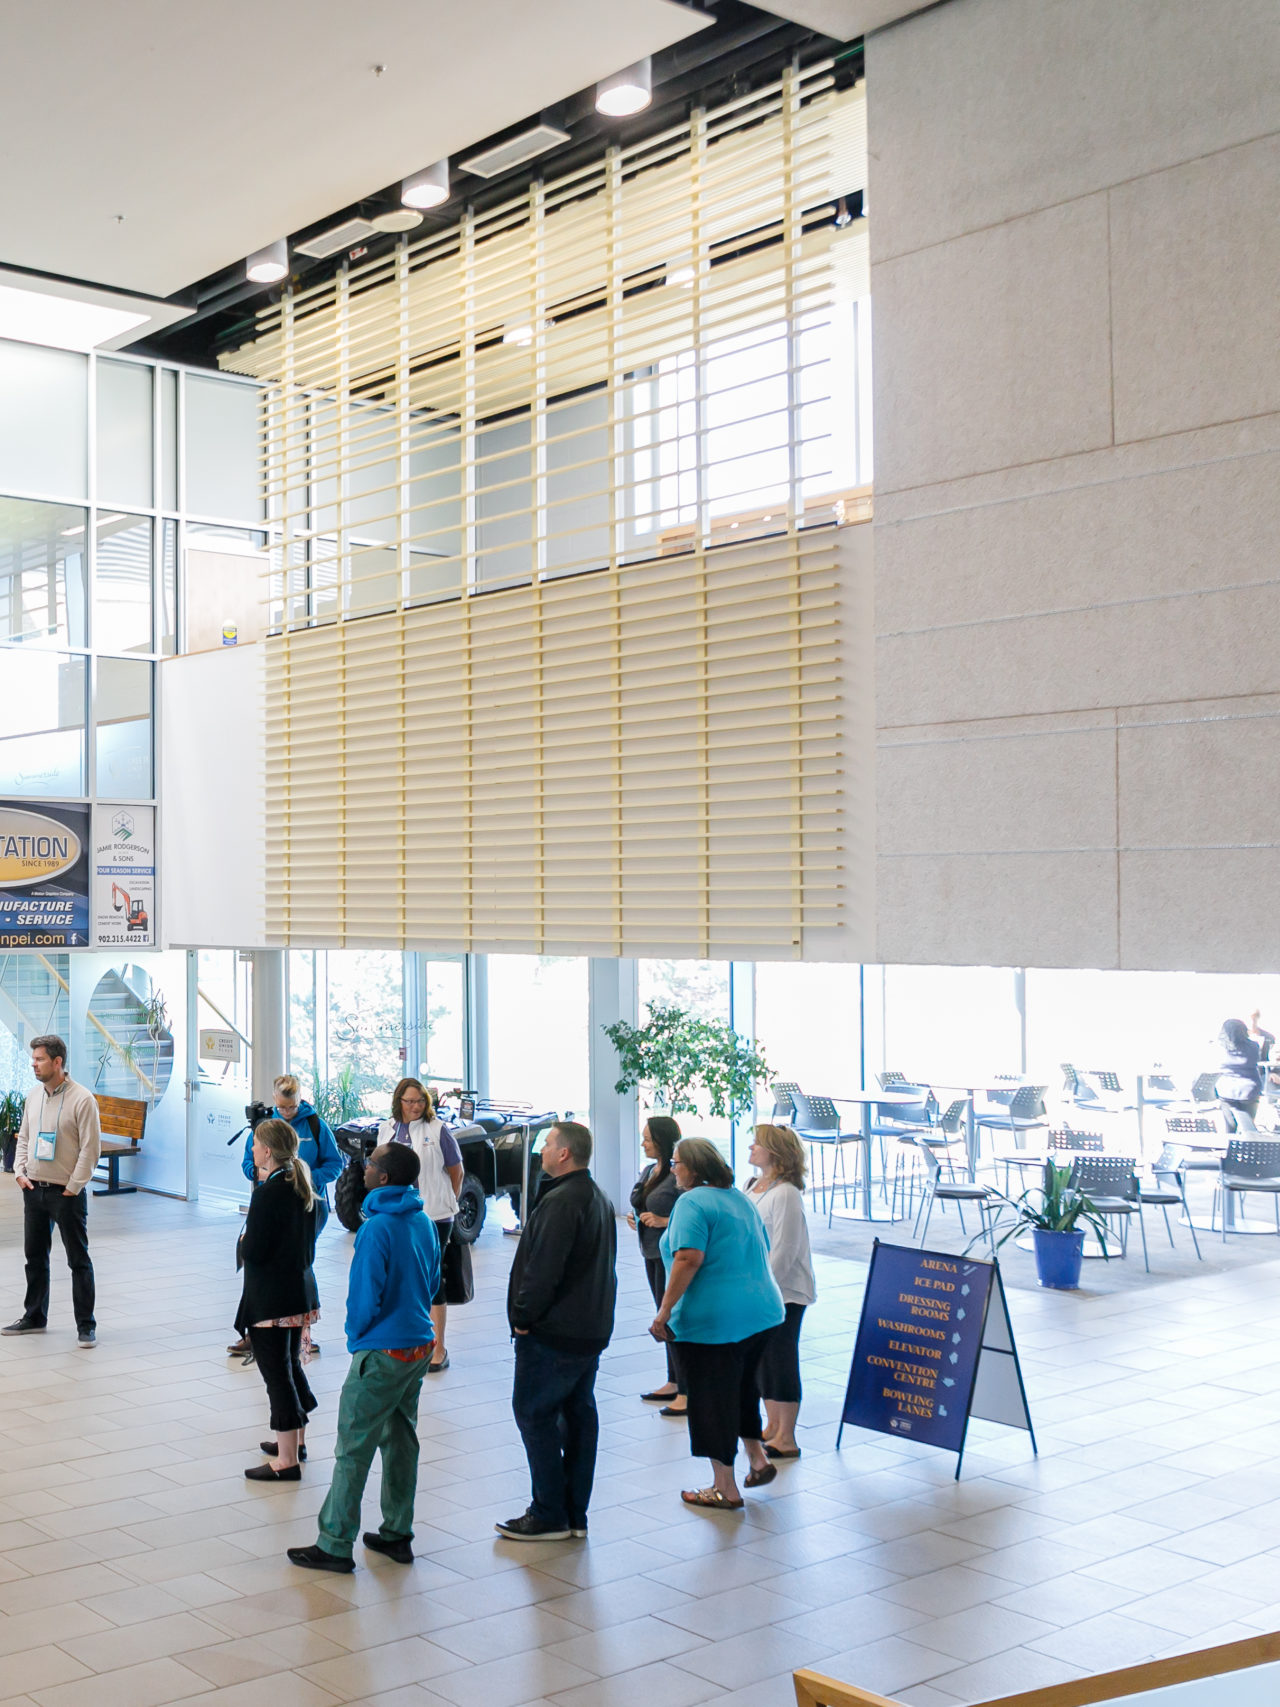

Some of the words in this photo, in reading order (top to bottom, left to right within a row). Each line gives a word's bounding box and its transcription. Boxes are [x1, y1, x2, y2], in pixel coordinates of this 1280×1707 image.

[21, 860, 41, 868] SINCE
[44, 860, 60, 868] 1989
[16, 914, 73, 926] SERVICE
[920, 1259, 958, 1274] ARENA
[914, 1277, 932, 1288] ICE
[933, 1281, 956, 1292] PAD
[898, 1293, 951, 1311] DRESSING
[911, 1306, 950, 1321] ROOMS
[878, 1318, 946, 1341] WASHROOMS
[888, 1340, 942, 1360] ELEVATOR
[867, 1355, 939, 1379] CONVENTION
[893, 1373, 936, 1389] CENTRE
[882, 1387, 934, 1408] BOWLING
[898, 1402, 933, 1418] LANES
